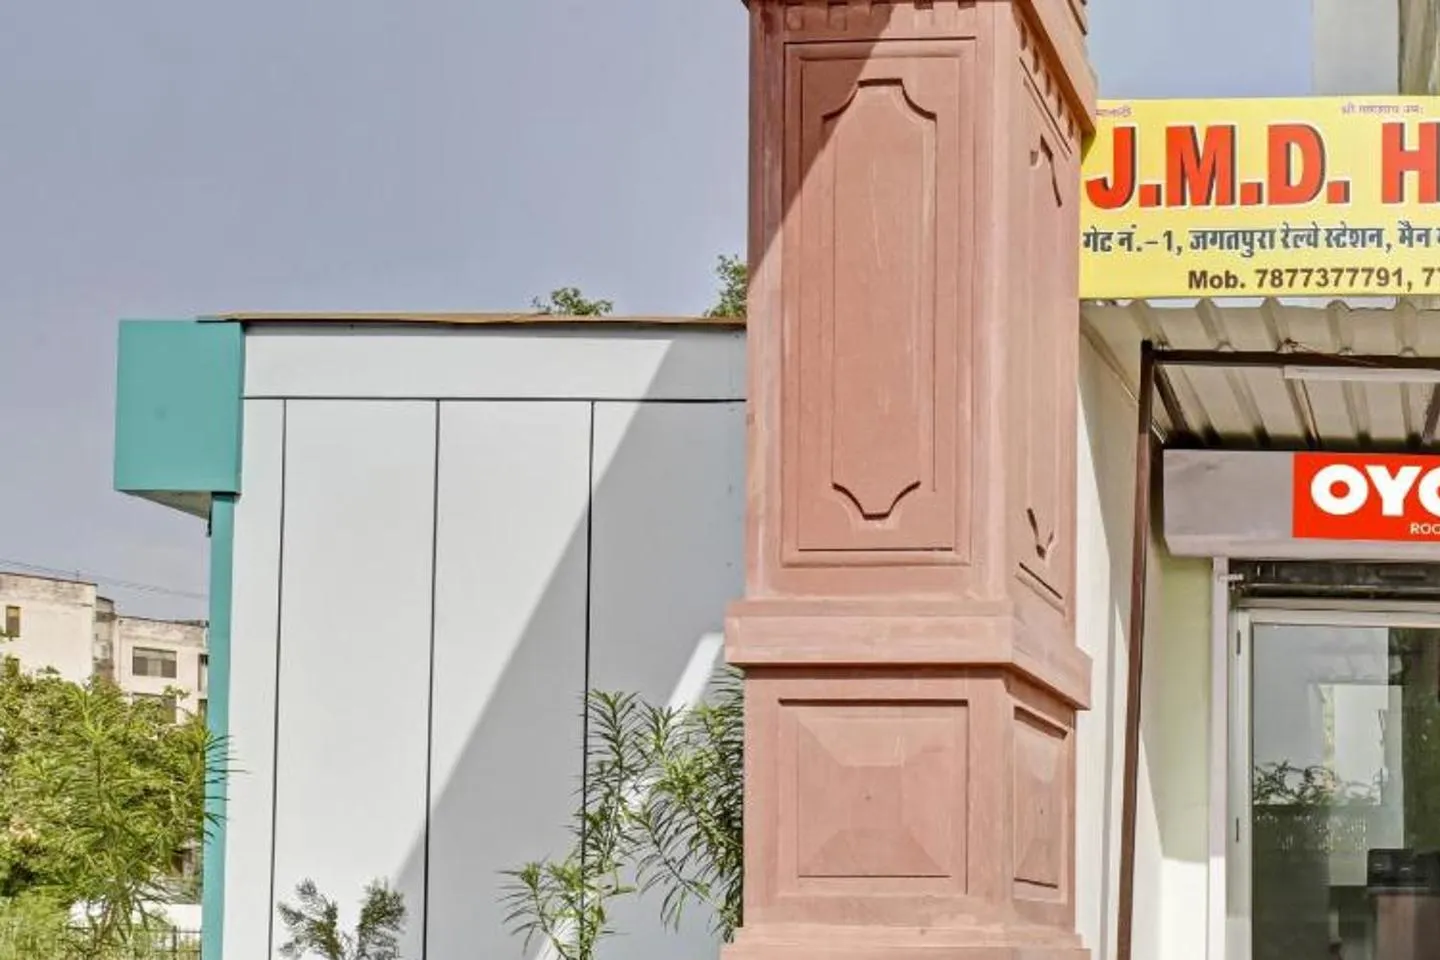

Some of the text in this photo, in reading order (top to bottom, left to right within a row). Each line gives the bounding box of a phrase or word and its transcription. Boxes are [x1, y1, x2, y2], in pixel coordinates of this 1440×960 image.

[1085, 124, 1351, 208] J.M.D.
[1083, 225, 1113, 253] गेट
[1189, 230, 1277, 258] जगतपुरा
[1324, 221, 1393, 253] स्टेशन,
[1398, 219, 1432, 249] मैन
[1187, 269, 1247, 290] Mob.
[1254, 266, 1413, 293] 7877377791,
